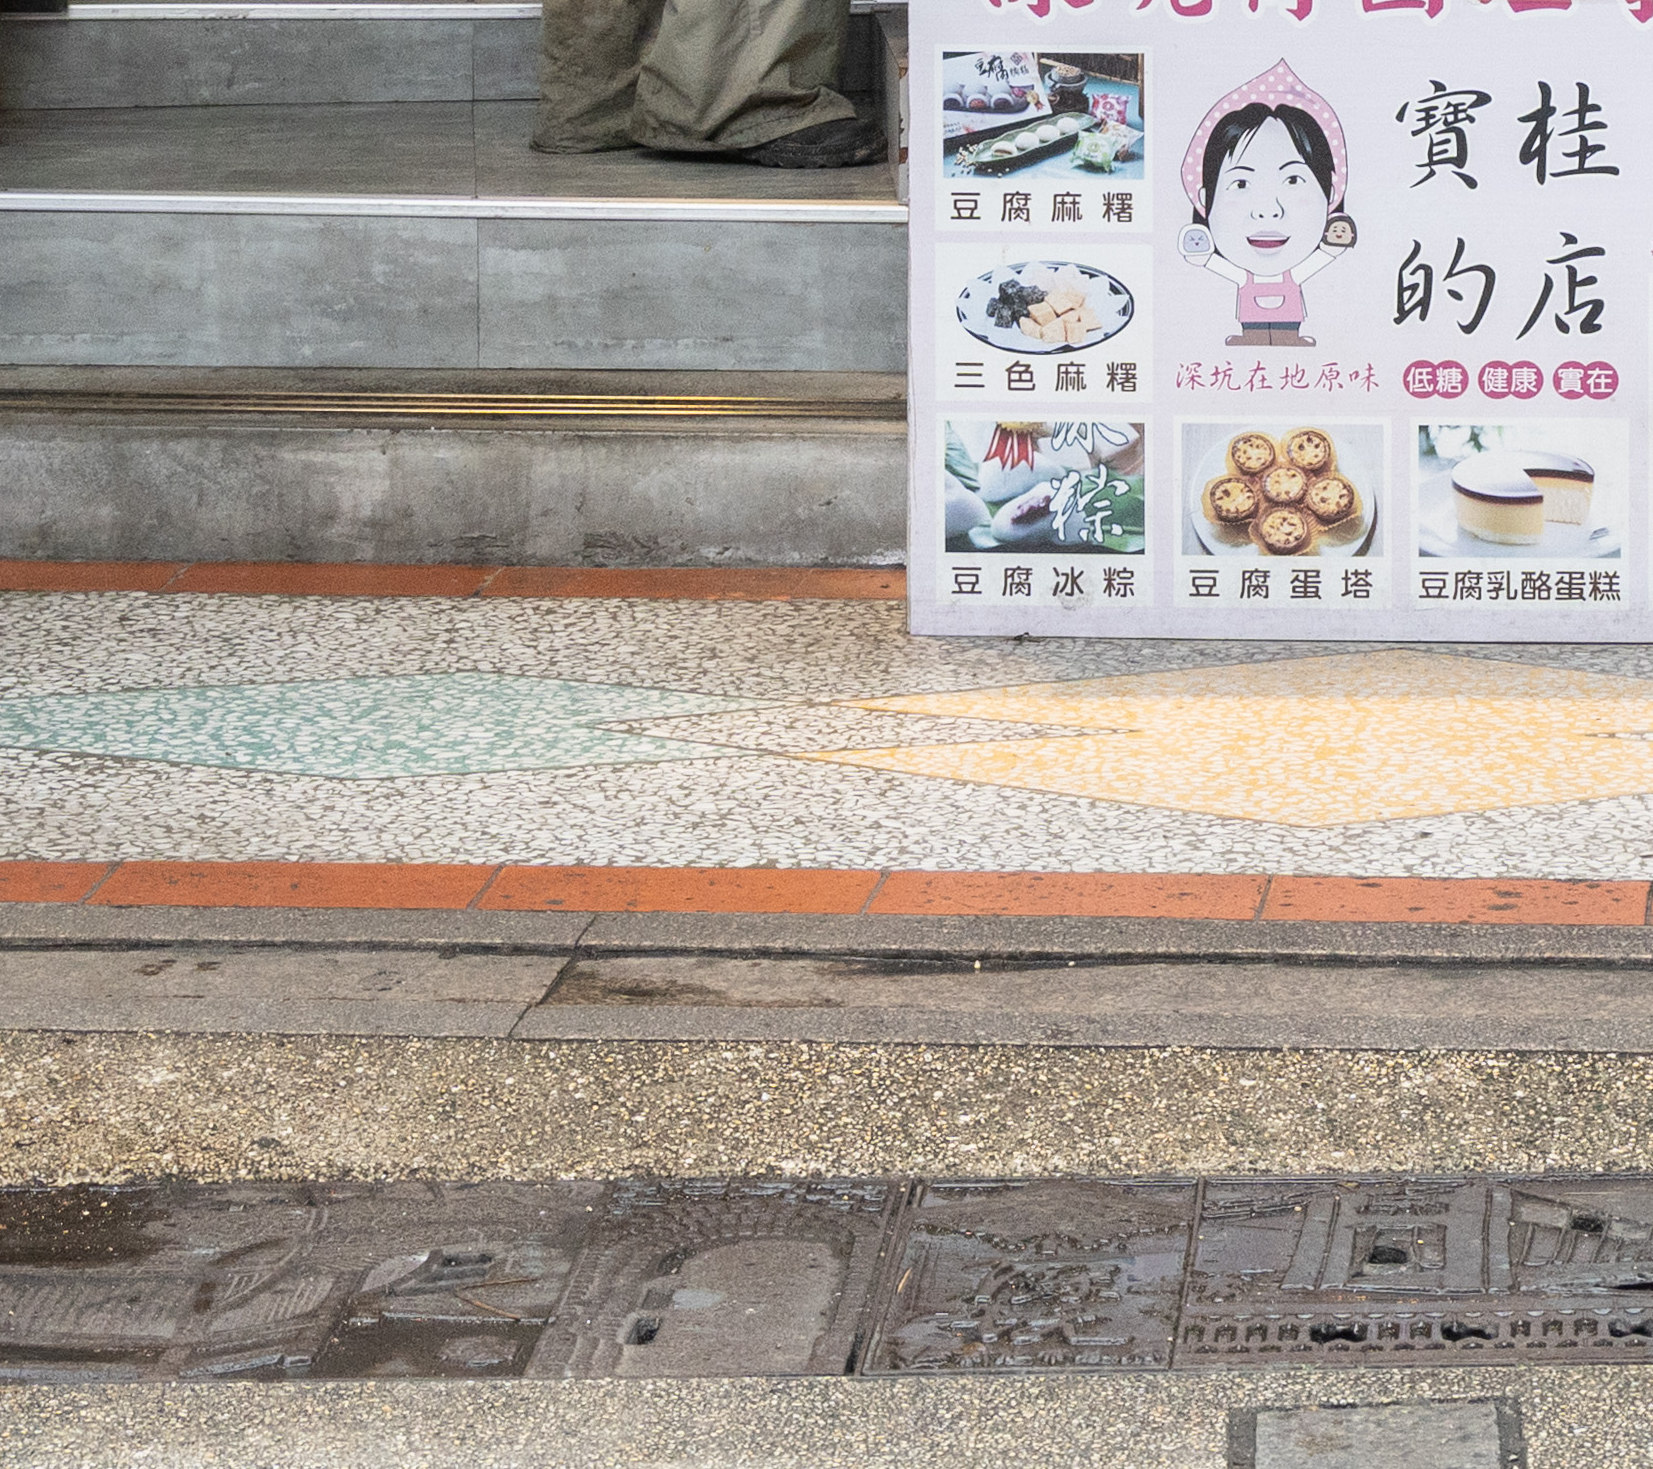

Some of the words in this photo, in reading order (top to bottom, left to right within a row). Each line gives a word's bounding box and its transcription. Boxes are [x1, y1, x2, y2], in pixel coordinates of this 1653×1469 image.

[1395, 80, 1621, 191] 寶桂
[950, 190, 1135, 223] 豆腐麻糬
[1393, 232, 1607, 341] 的店
[953, 360, 1139, 393] 三色麻糬
[1176, 361, 1380, 394] 深坑在地原味
[1406, 368, 1464, 394] 低糖
[1481, 368, 1540, 394] 健康
[1556, 368, 1615, 394] 實在
[951, 566, 1136, 599] 豆腐冰粽
[1188, 568, 1373, 601] 豆腐蛋塔
[1418, 570, 1622, 603] 豆腐乳酪蛋糕
